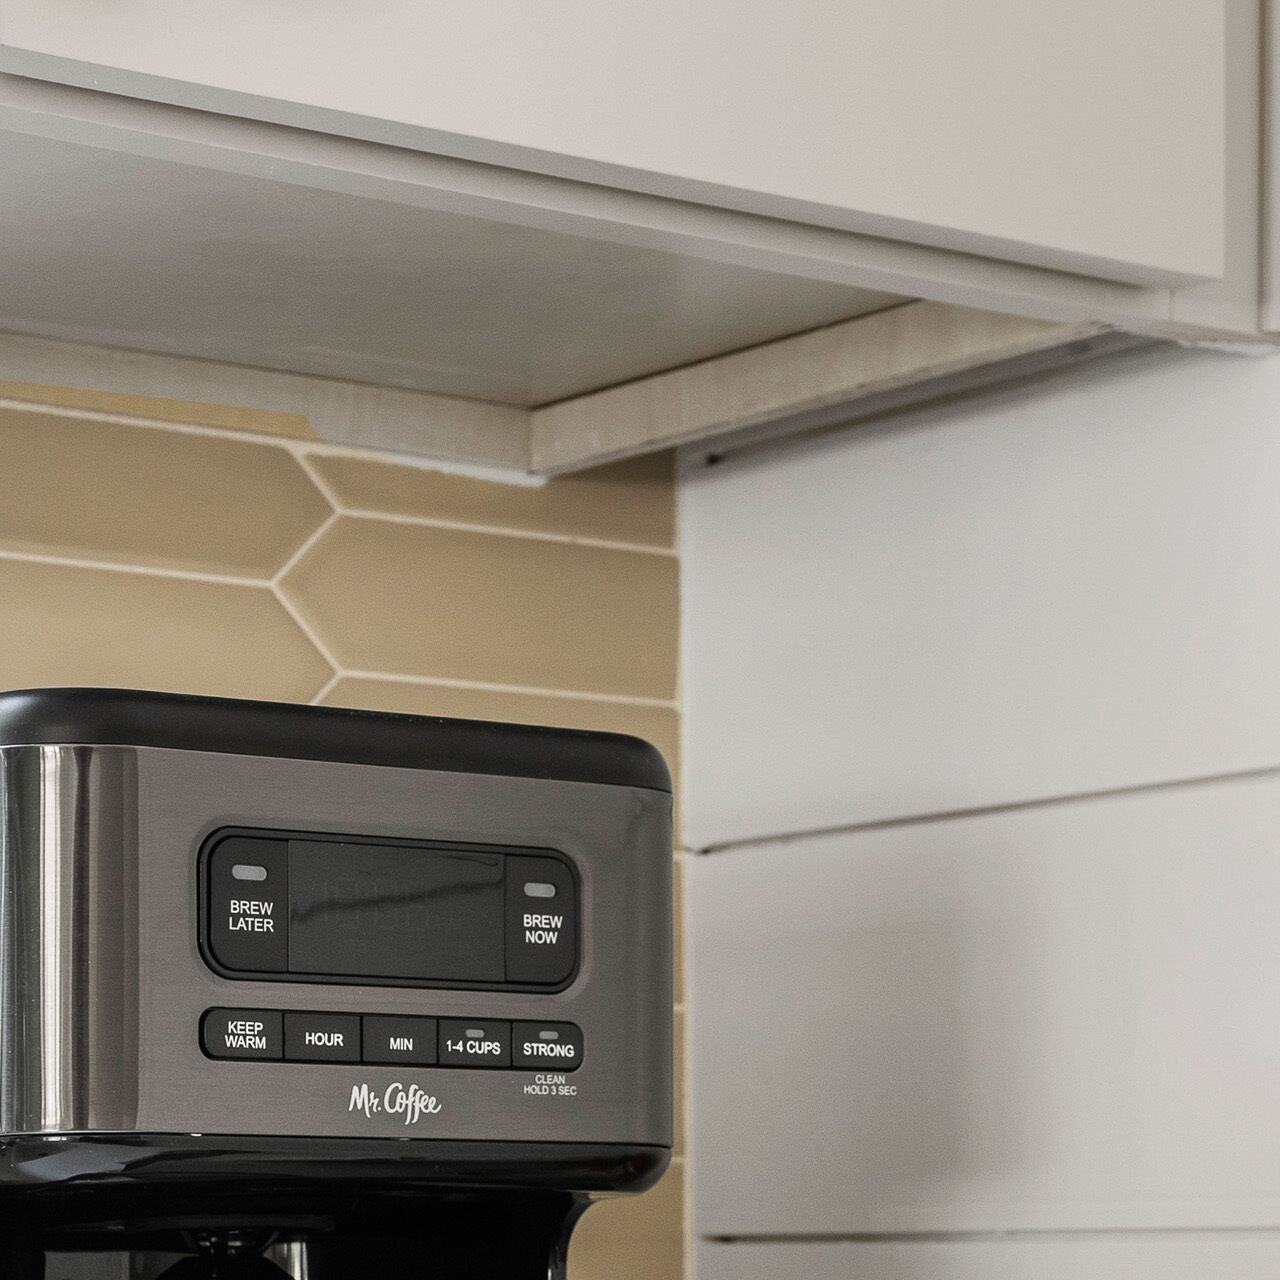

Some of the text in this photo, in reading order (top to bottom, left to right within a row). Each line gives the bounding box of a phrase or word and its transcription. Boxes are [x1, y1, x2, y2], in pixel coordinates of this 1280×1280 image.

[230, 900, 273, 916] BREW
[229, 916, 274, 933] LATER
[523, 914, 563, 930] BREW
[525, 929, 558, 945] NOW
[227, 1020, 264, 1035] KEEP
[225, 1033, 267, 1050] WARM
[305, 1031, 344, 1047] HOUR
[389, 1037, 414, 1051] MIN
[446, 1040, 501, 1056] 1-4 CUPS
[523, 1041, 575, 1058] STRONG
[535, 1074, 566, 1086] CLEAN
[523, 1084, 577, 1096] HOLD 3 SEC
[348, 1082, 442, 1125] Mr. Coffee
